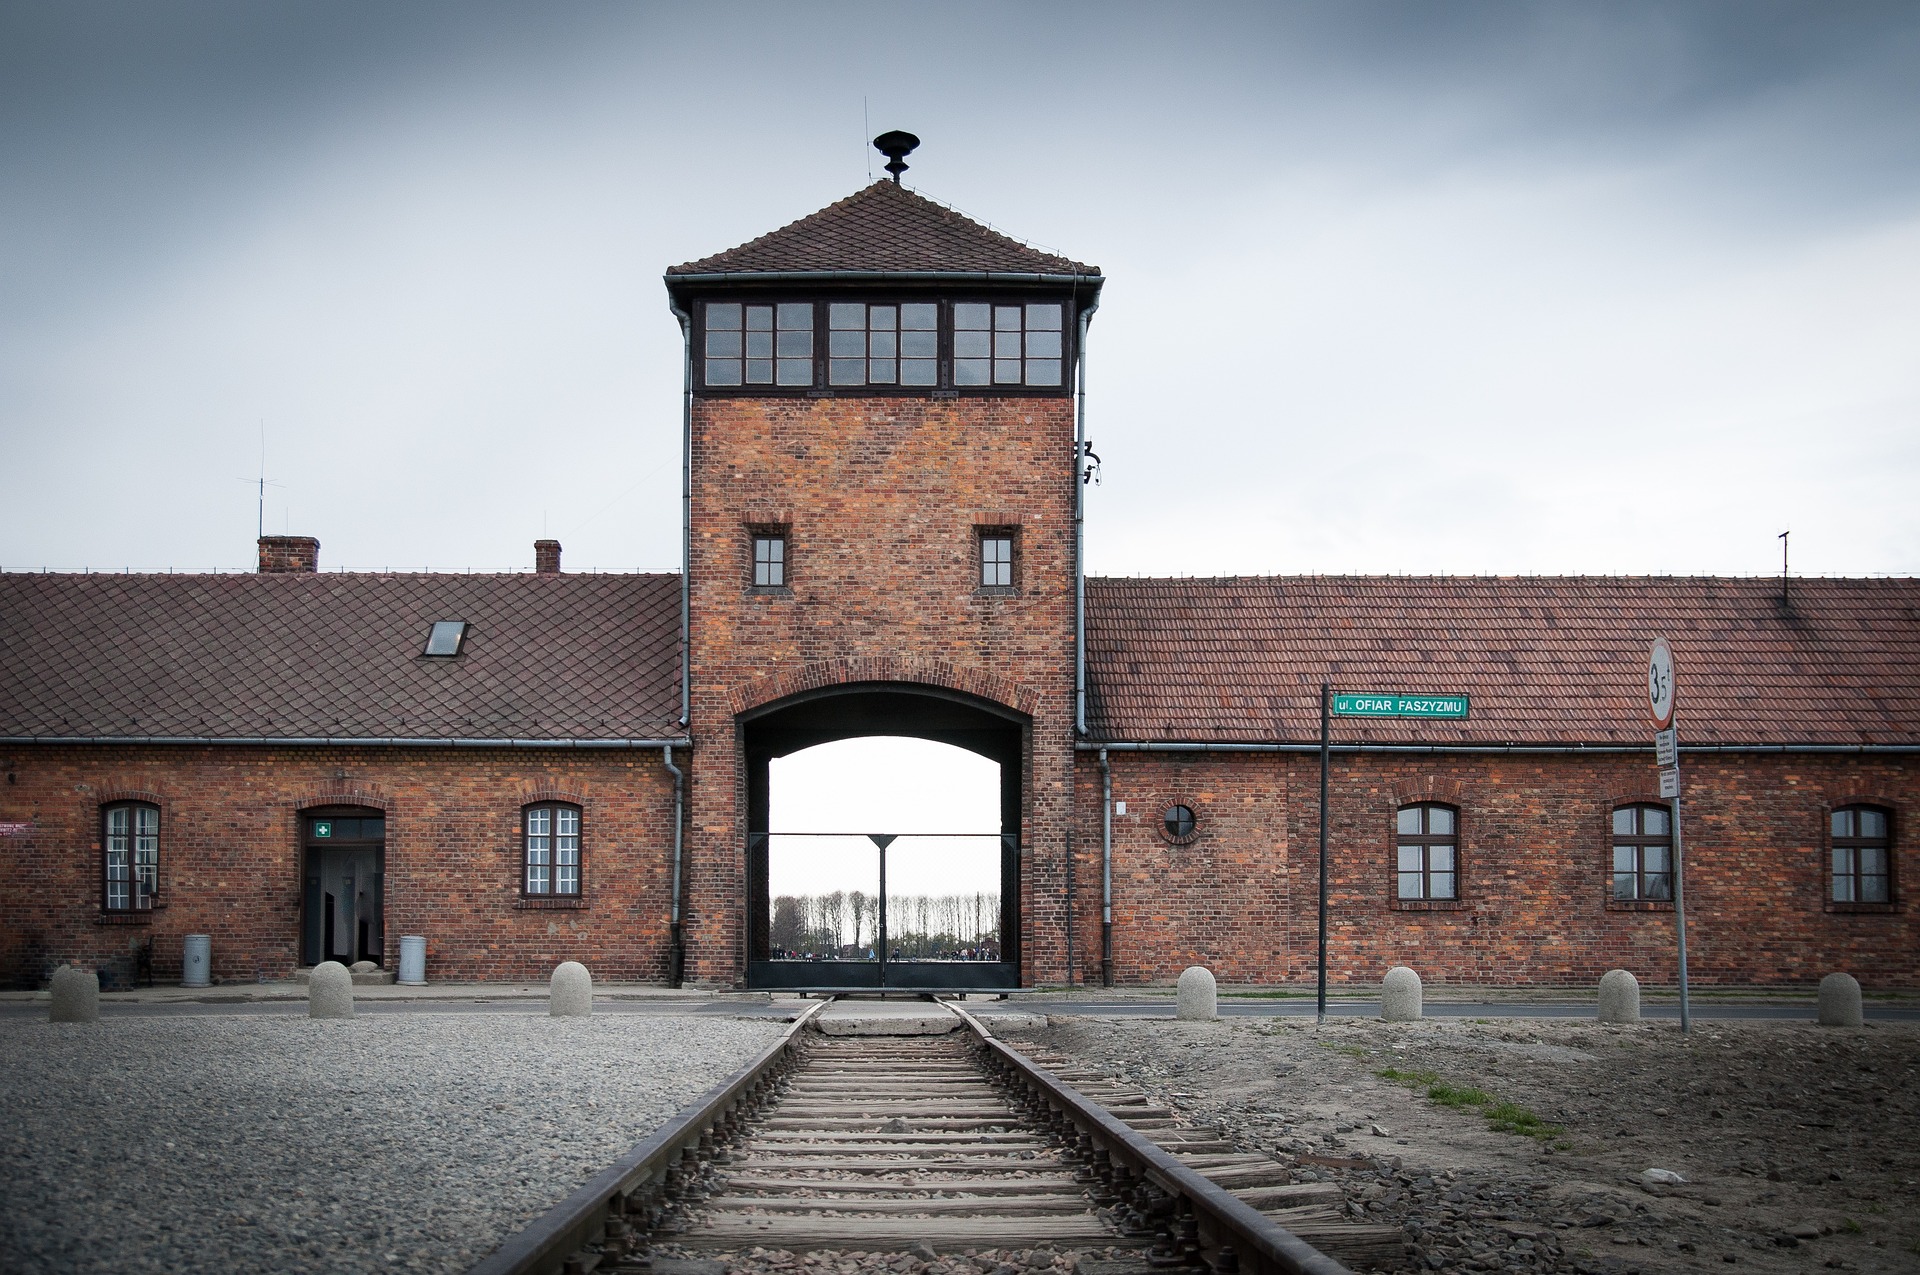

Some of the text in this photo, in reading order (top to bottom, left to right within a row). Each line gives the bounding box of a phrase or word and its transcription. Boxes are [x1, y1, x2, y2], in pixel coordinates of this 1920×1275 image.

[1339, 700, 1462, 712] ul. OFIAR FASZYZMU
